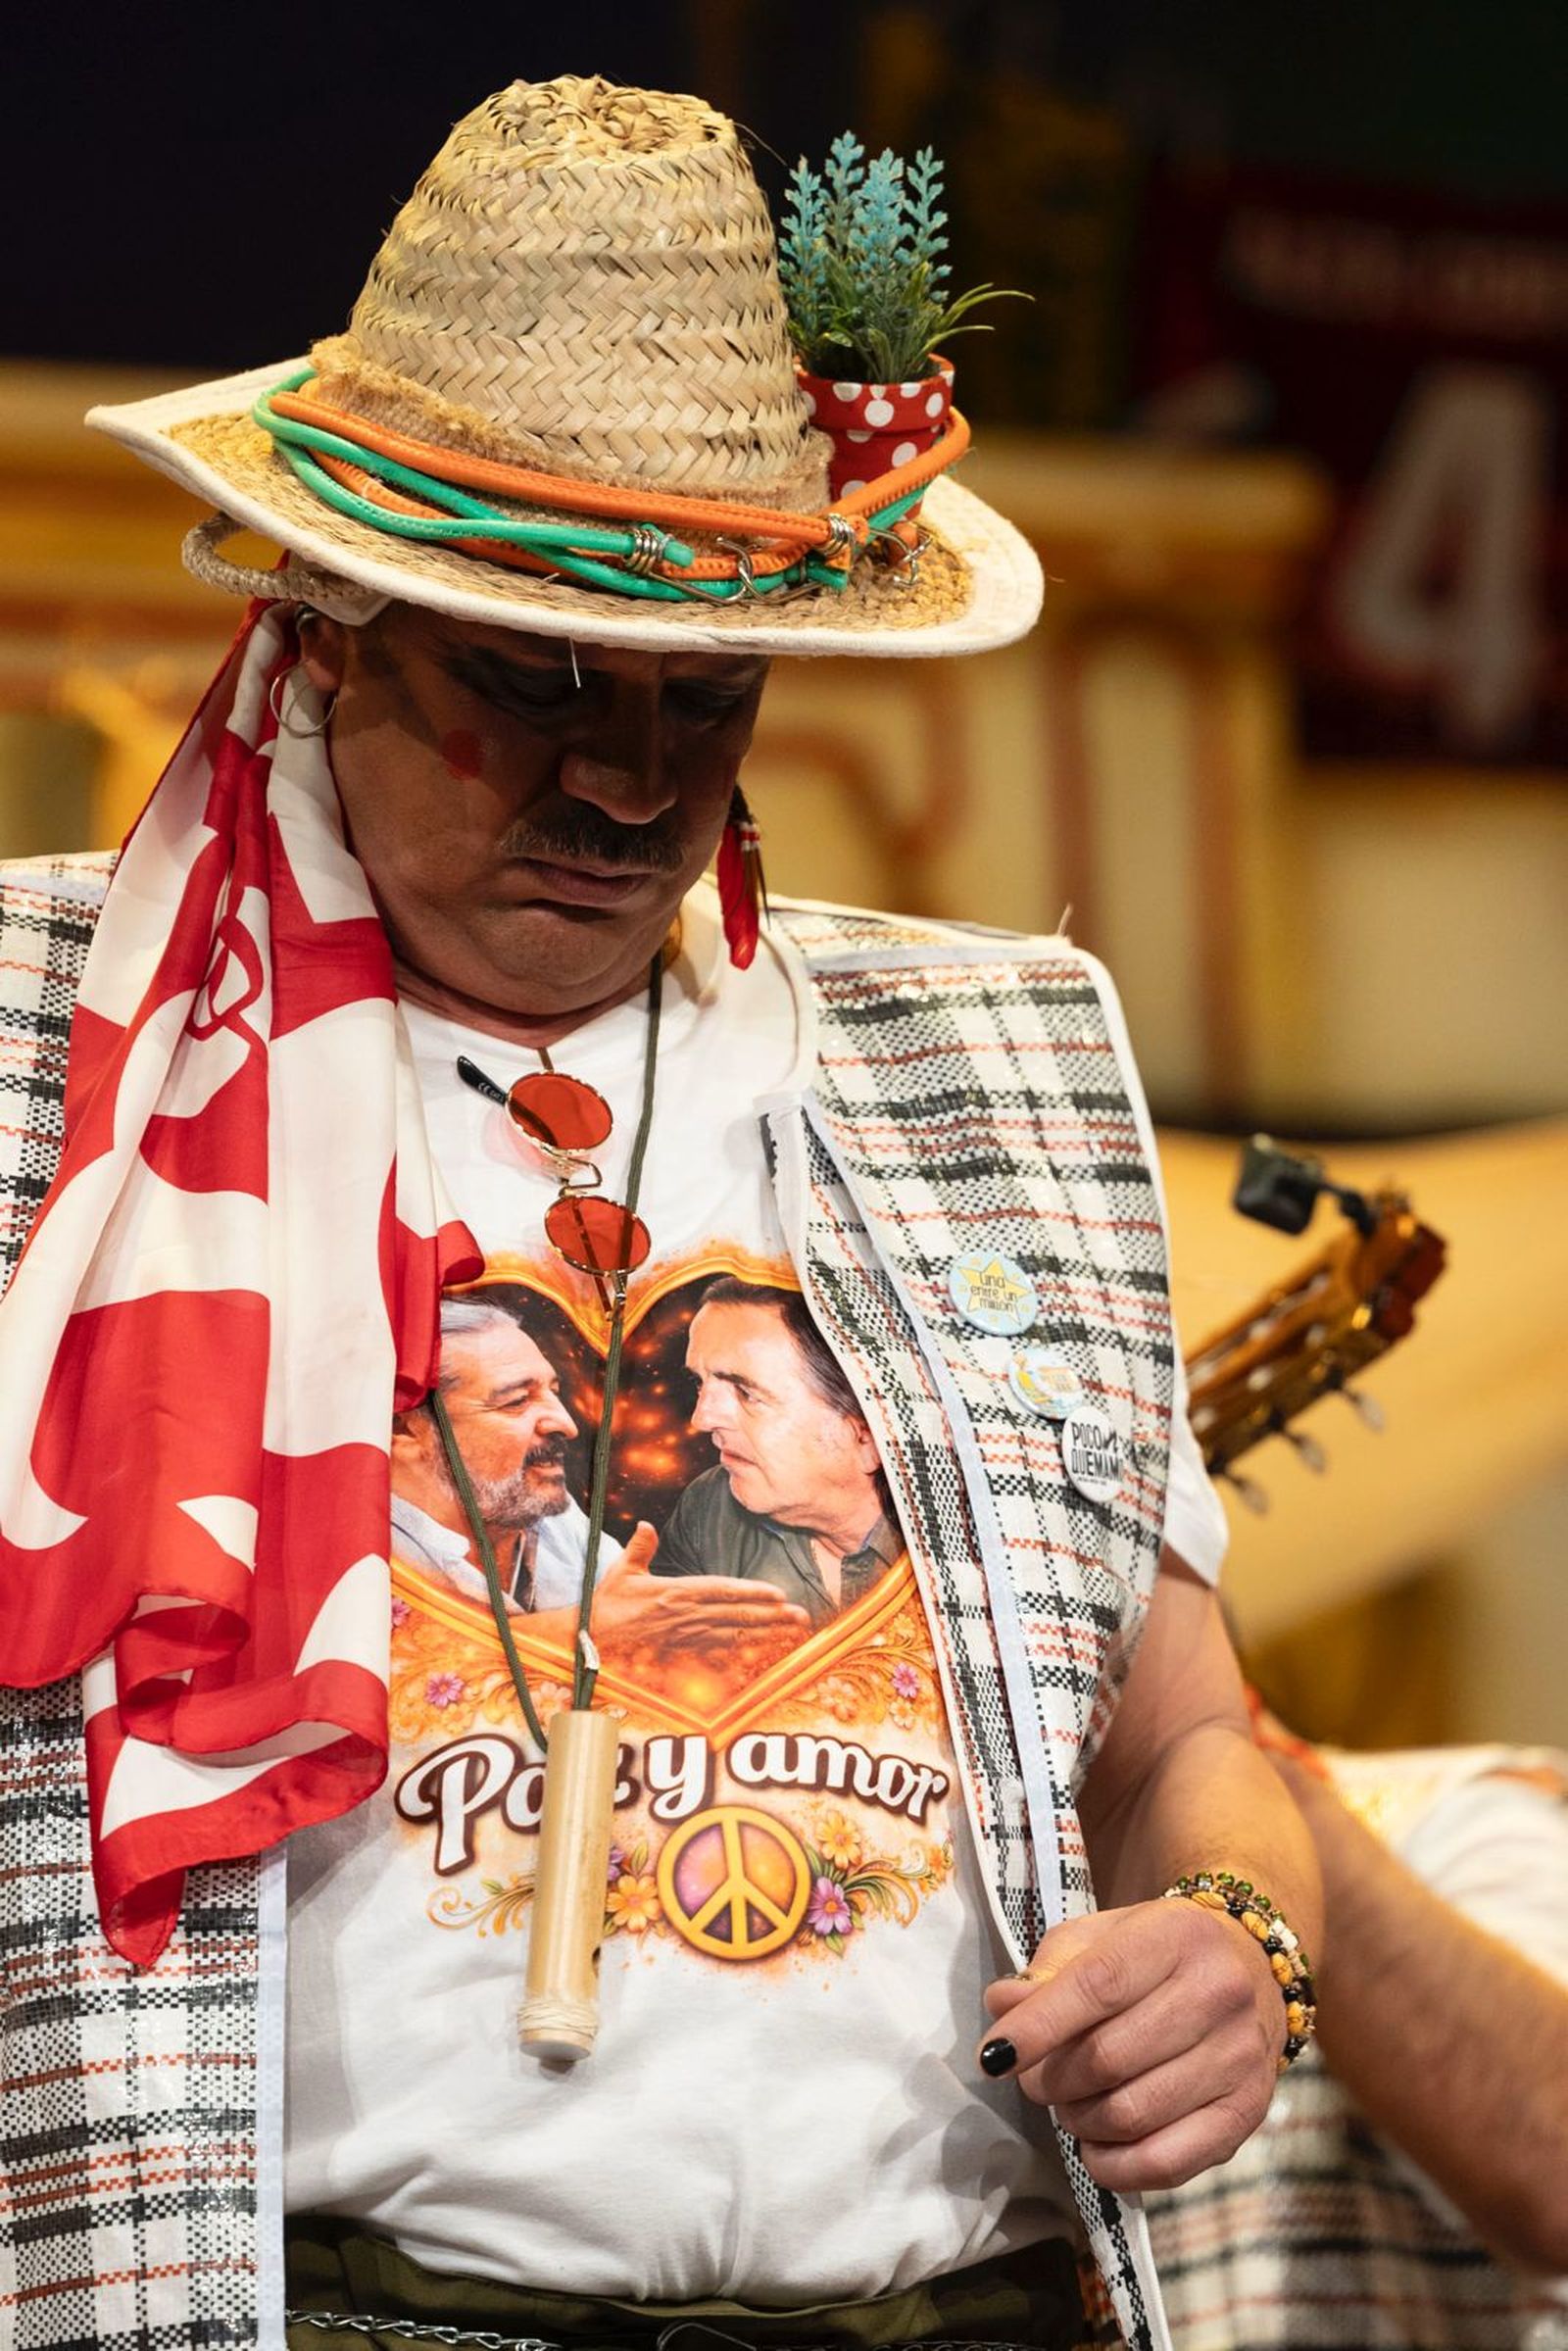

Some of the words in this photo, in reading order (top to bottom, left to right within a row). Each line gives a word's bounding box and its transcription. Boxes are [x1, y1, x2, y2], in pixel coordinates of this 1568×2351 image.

[1341, 367, 1544, 740] 4
[980, 1272, 1005, 1288] una
[1071, 1422, 1102, 1450] POCO
[644, 1734, 714, 1826] y
[727, 1731, 951, 1826] amor
